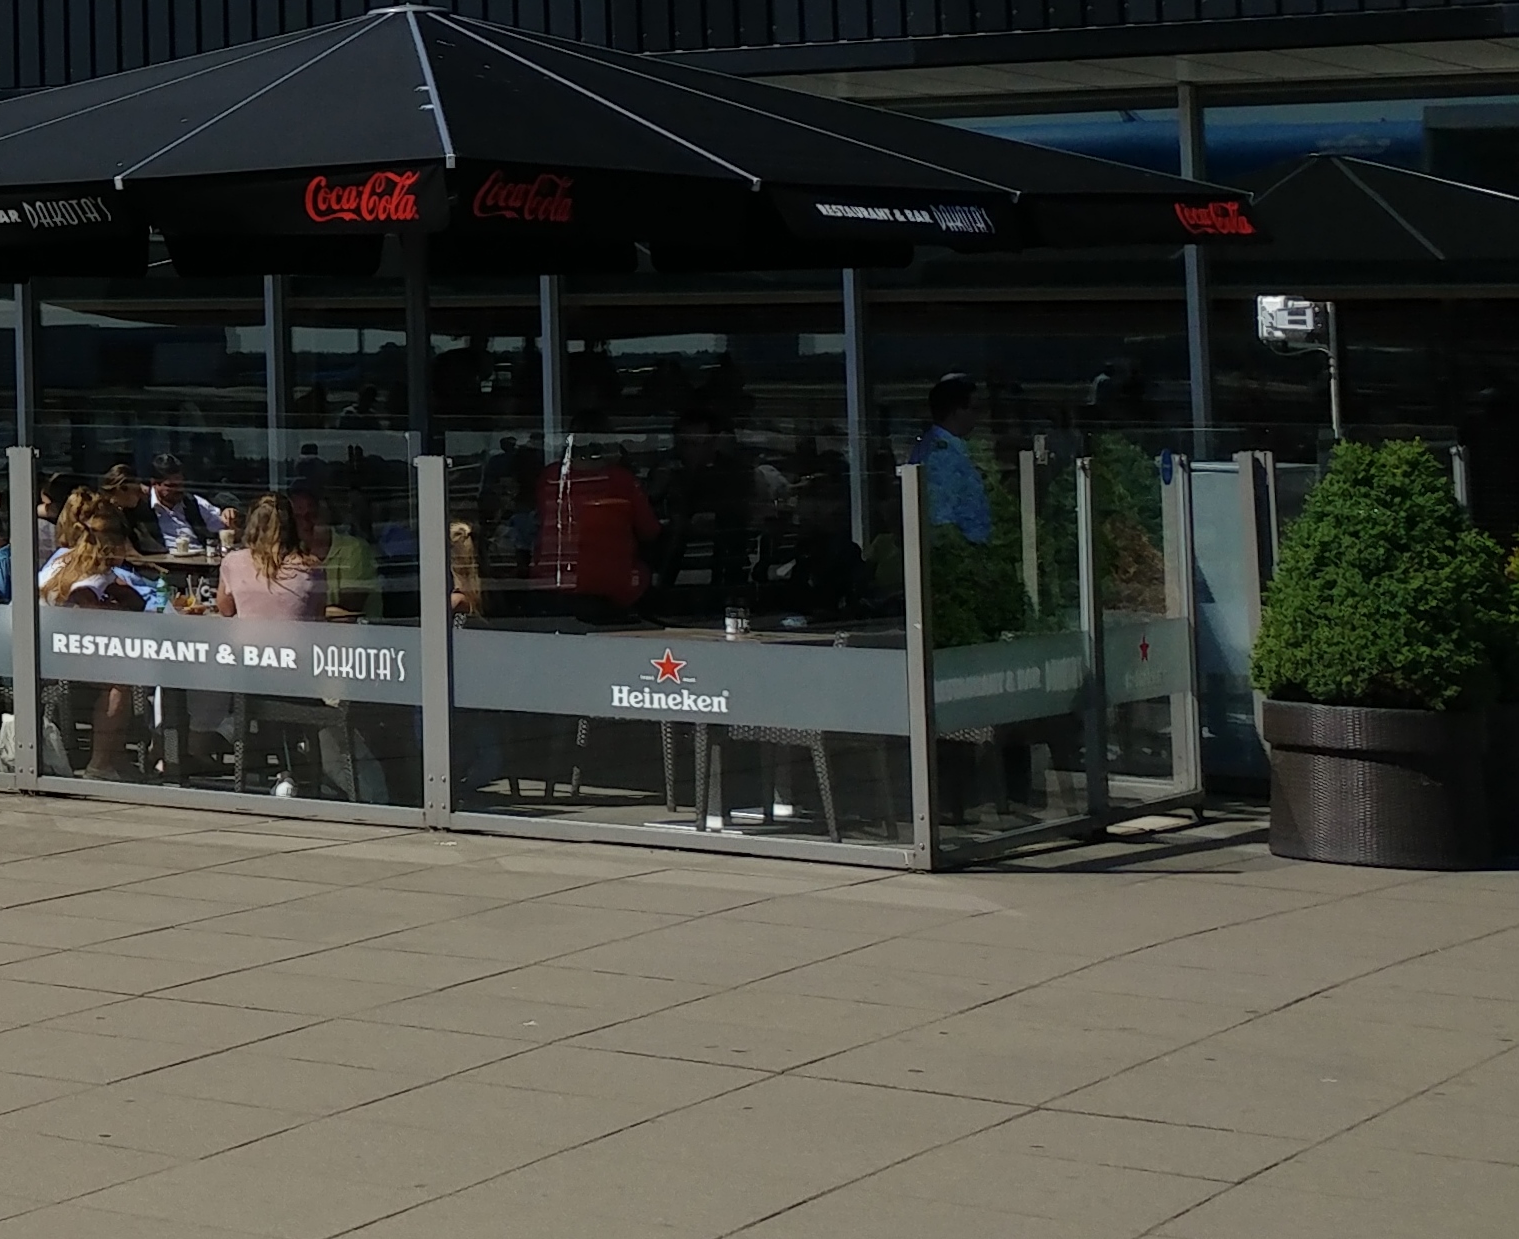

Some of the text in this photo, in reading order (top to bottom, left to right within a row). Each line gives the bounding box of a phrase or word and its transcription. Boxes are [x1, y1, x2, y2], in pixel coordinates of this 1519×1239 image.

[21, 196, 112, 229] DAKOTA'S
[815, 203, 894, 221] RESTAURANT
[906, 209, 933, 223] BAR
[52, 633, 406, 683] RESTAURANT & BAR DAKOTA'S
[611, 685, 729, 713] Heineken
